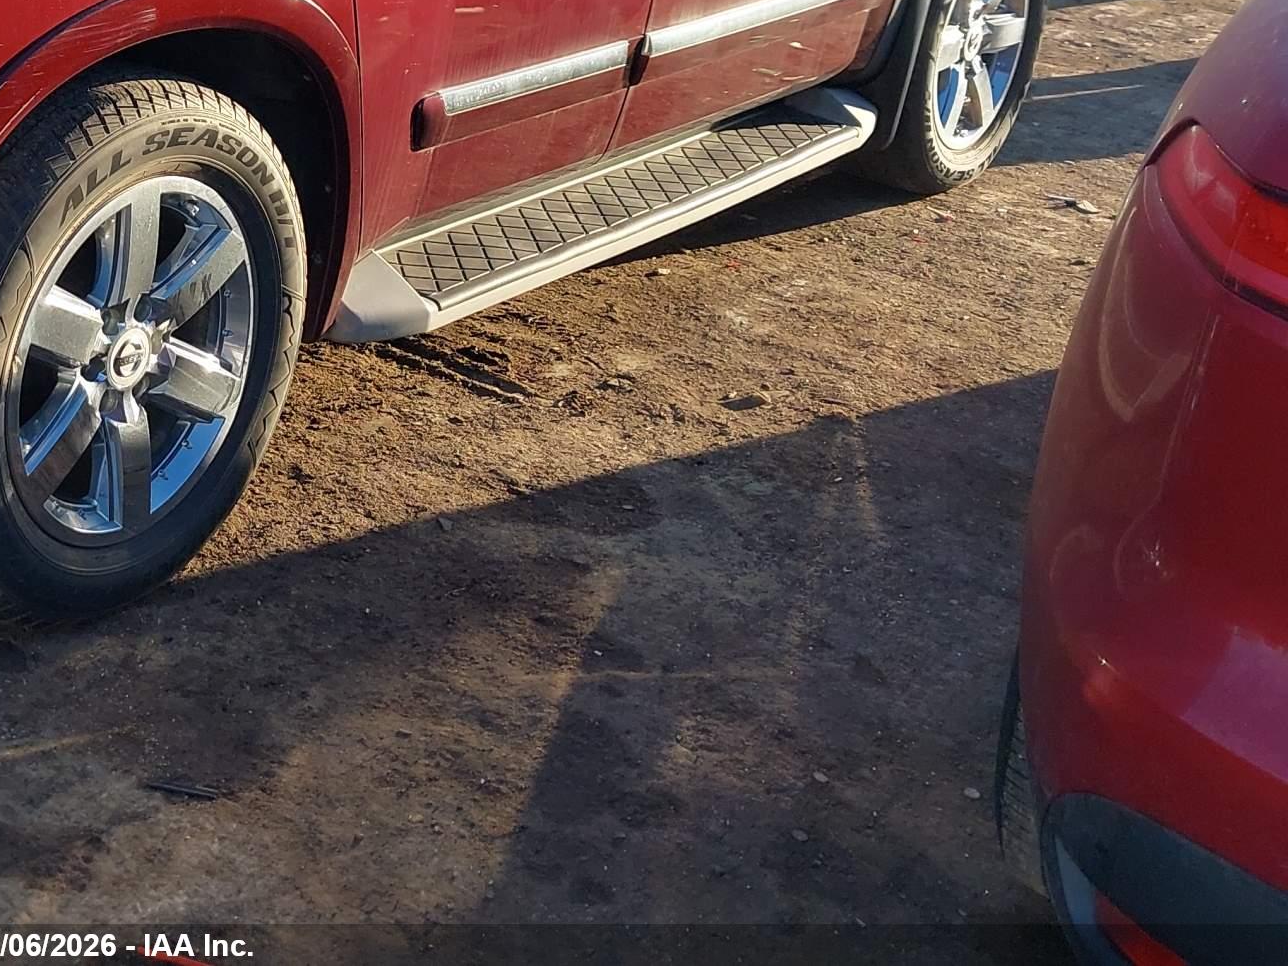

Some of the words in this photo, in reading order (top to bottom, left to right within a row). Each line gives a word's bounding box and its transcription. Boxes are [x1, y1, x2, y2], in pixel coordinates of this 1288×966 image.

[59, 150, 132, 229] ALL
[142, 127, 275, 187] SEASON
[925, 138, 976, 182] SEASON
